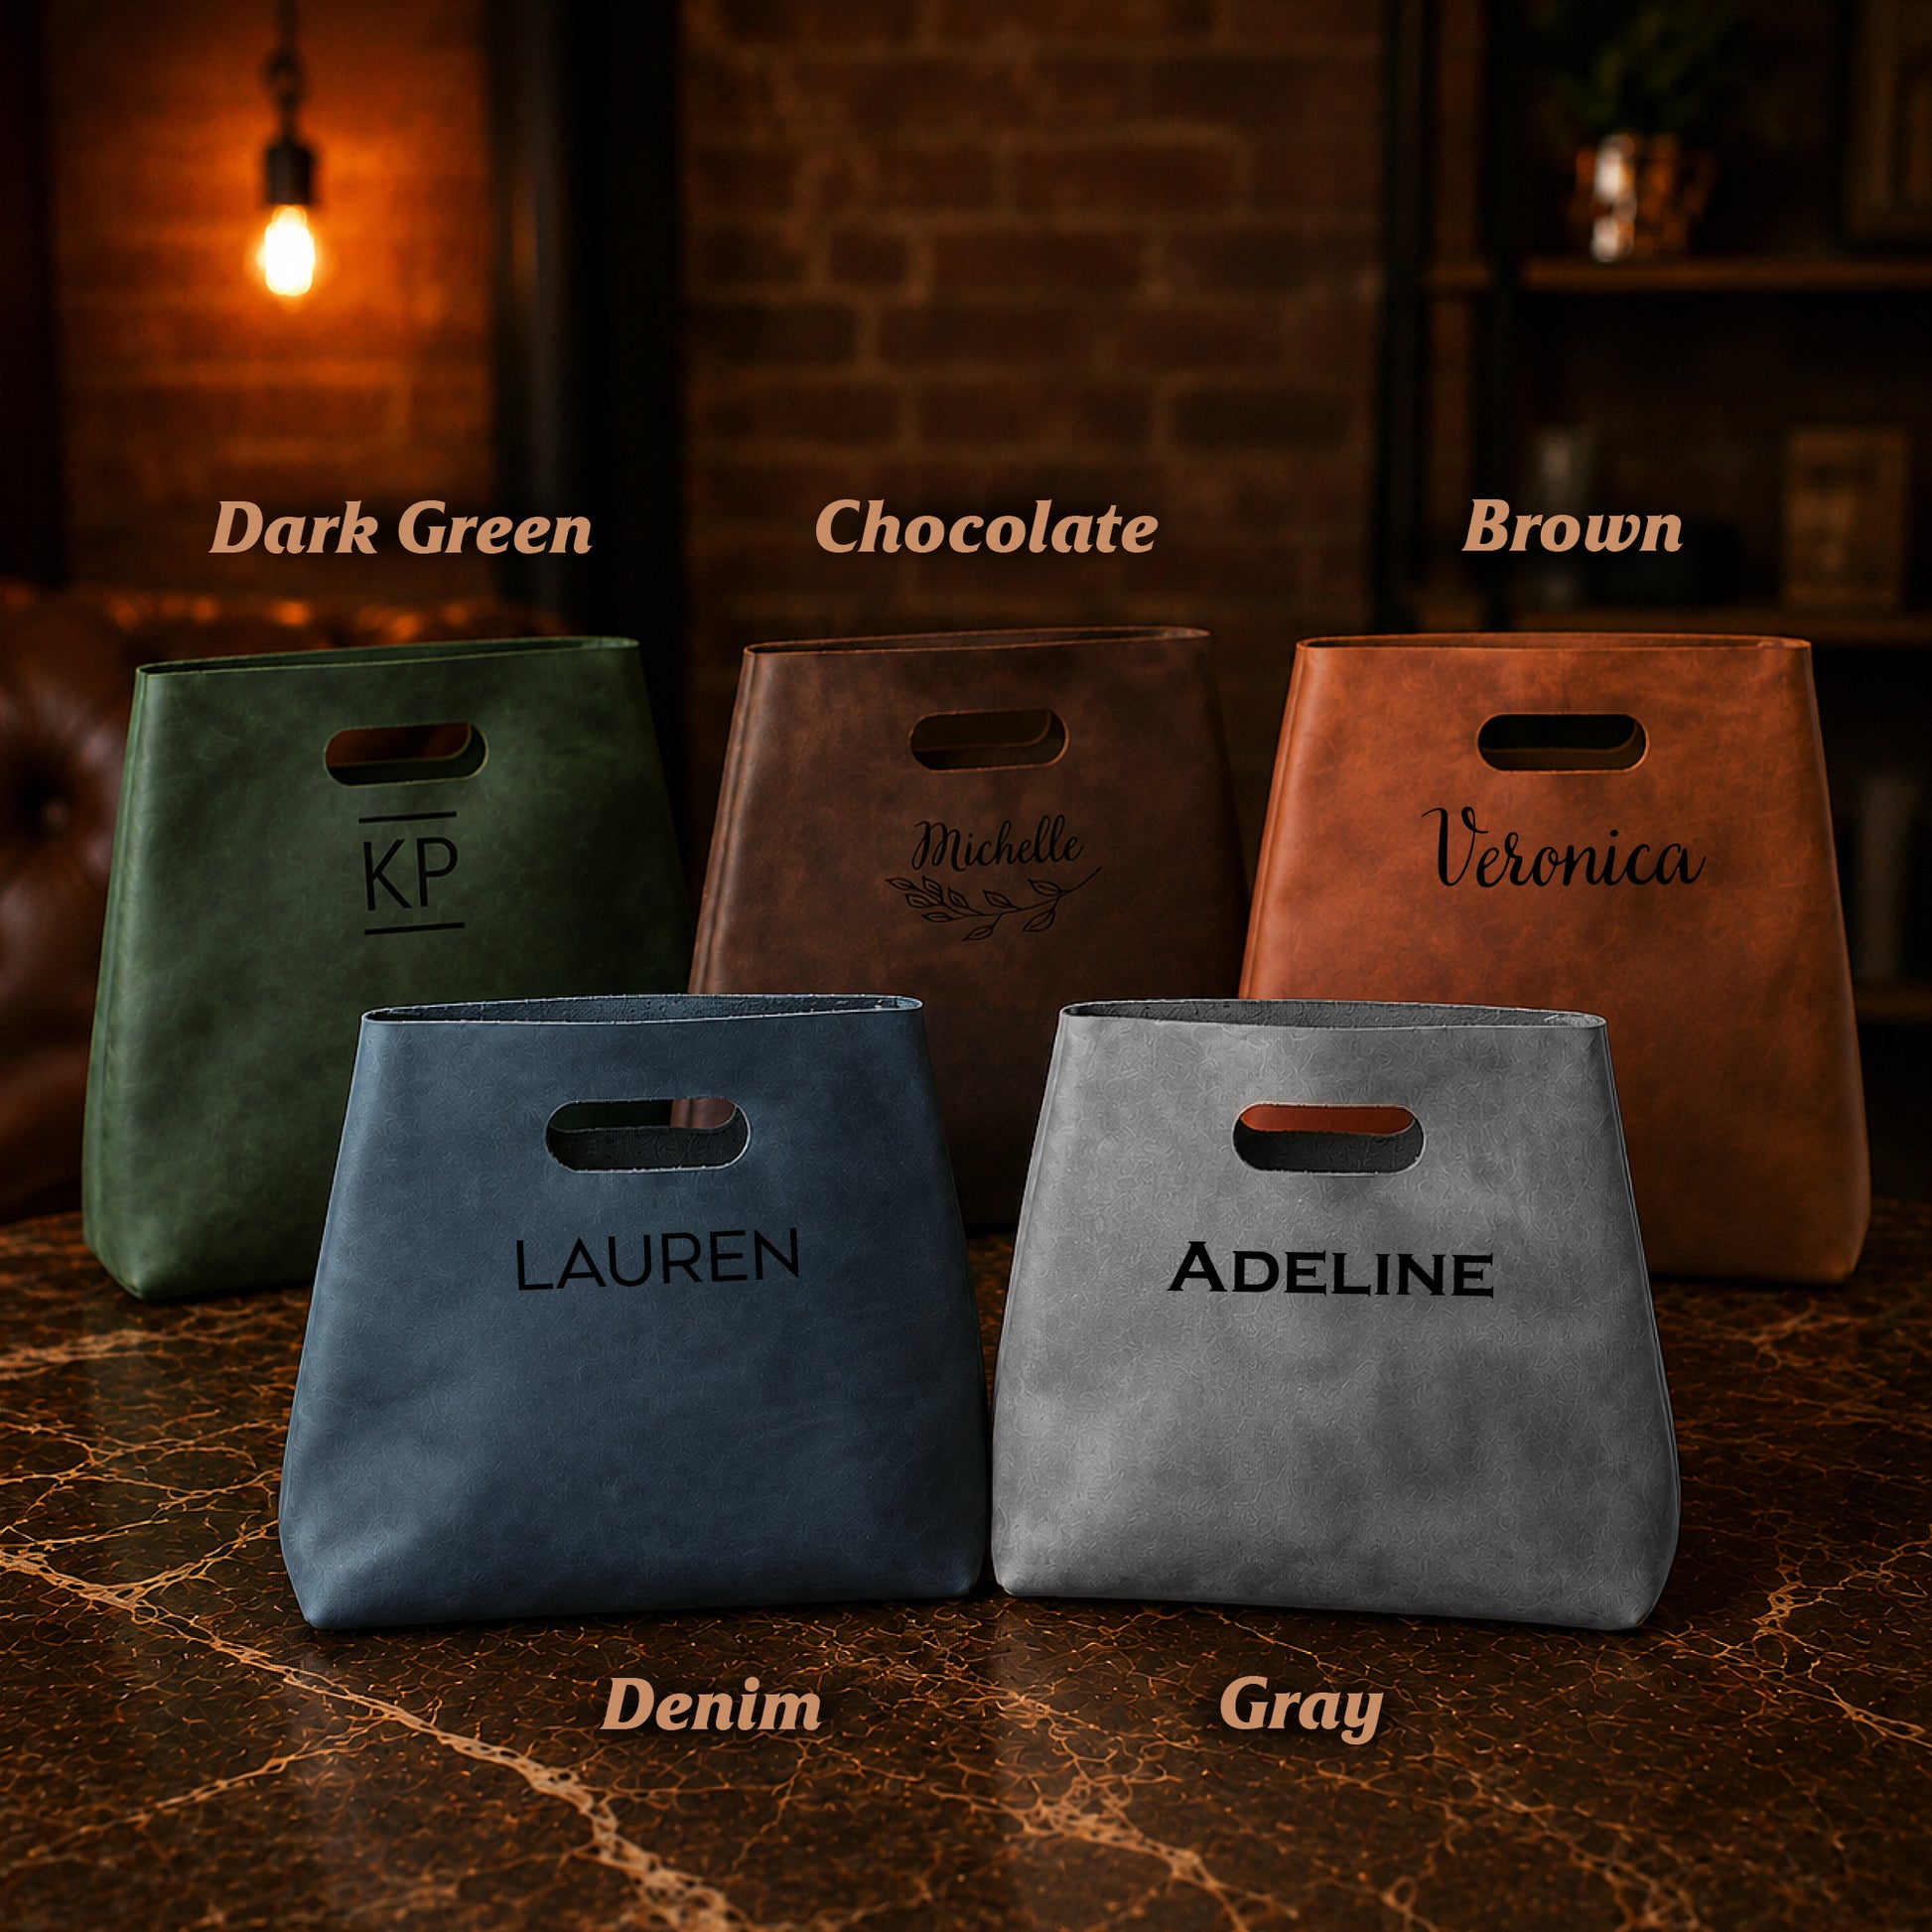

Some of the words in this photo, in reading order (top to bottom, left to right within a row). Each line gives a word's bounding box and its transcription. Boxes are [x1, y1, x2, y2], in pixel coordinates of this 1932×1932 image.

[362, 836, 459, 911] KP
[910, 813, 1085, 873] Michelle
[1421, 805, 1707, 889] Veronica
[515, 1227, 800, 1292] LAUREN
[1167, 1240, 1494, 1300] ADELINE
